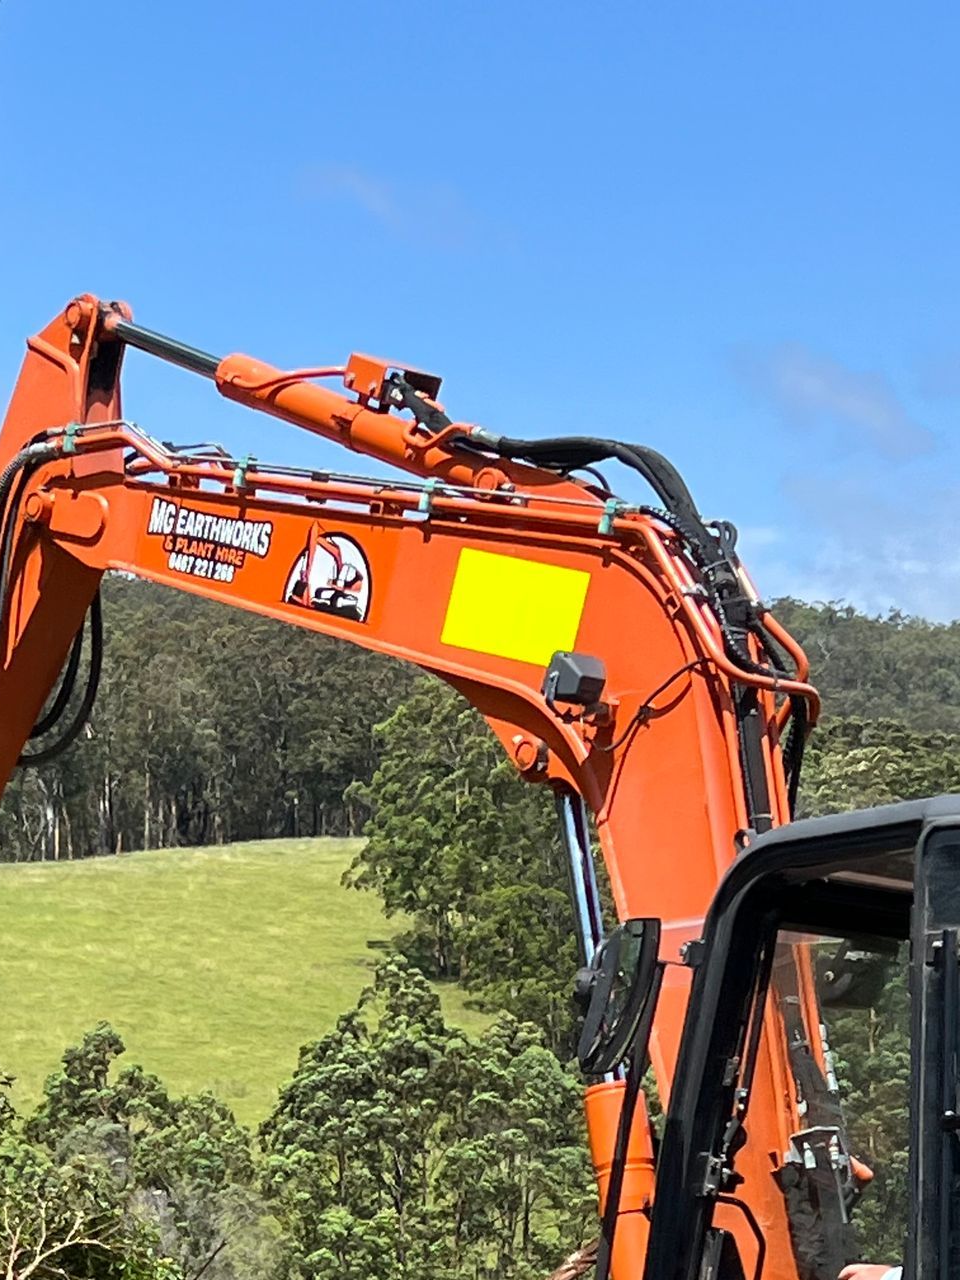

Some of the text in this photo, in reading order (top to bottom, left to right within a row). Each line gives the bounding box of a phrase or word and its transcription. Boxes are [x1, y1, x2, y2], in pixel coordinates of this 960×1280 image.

[148, 498, 272, 556] MG EARTHWORKS
[175, 537, 214, 558] PLANT
[216, 546, 245, 566] HIRE
[193, 558, 214, 578] 221
